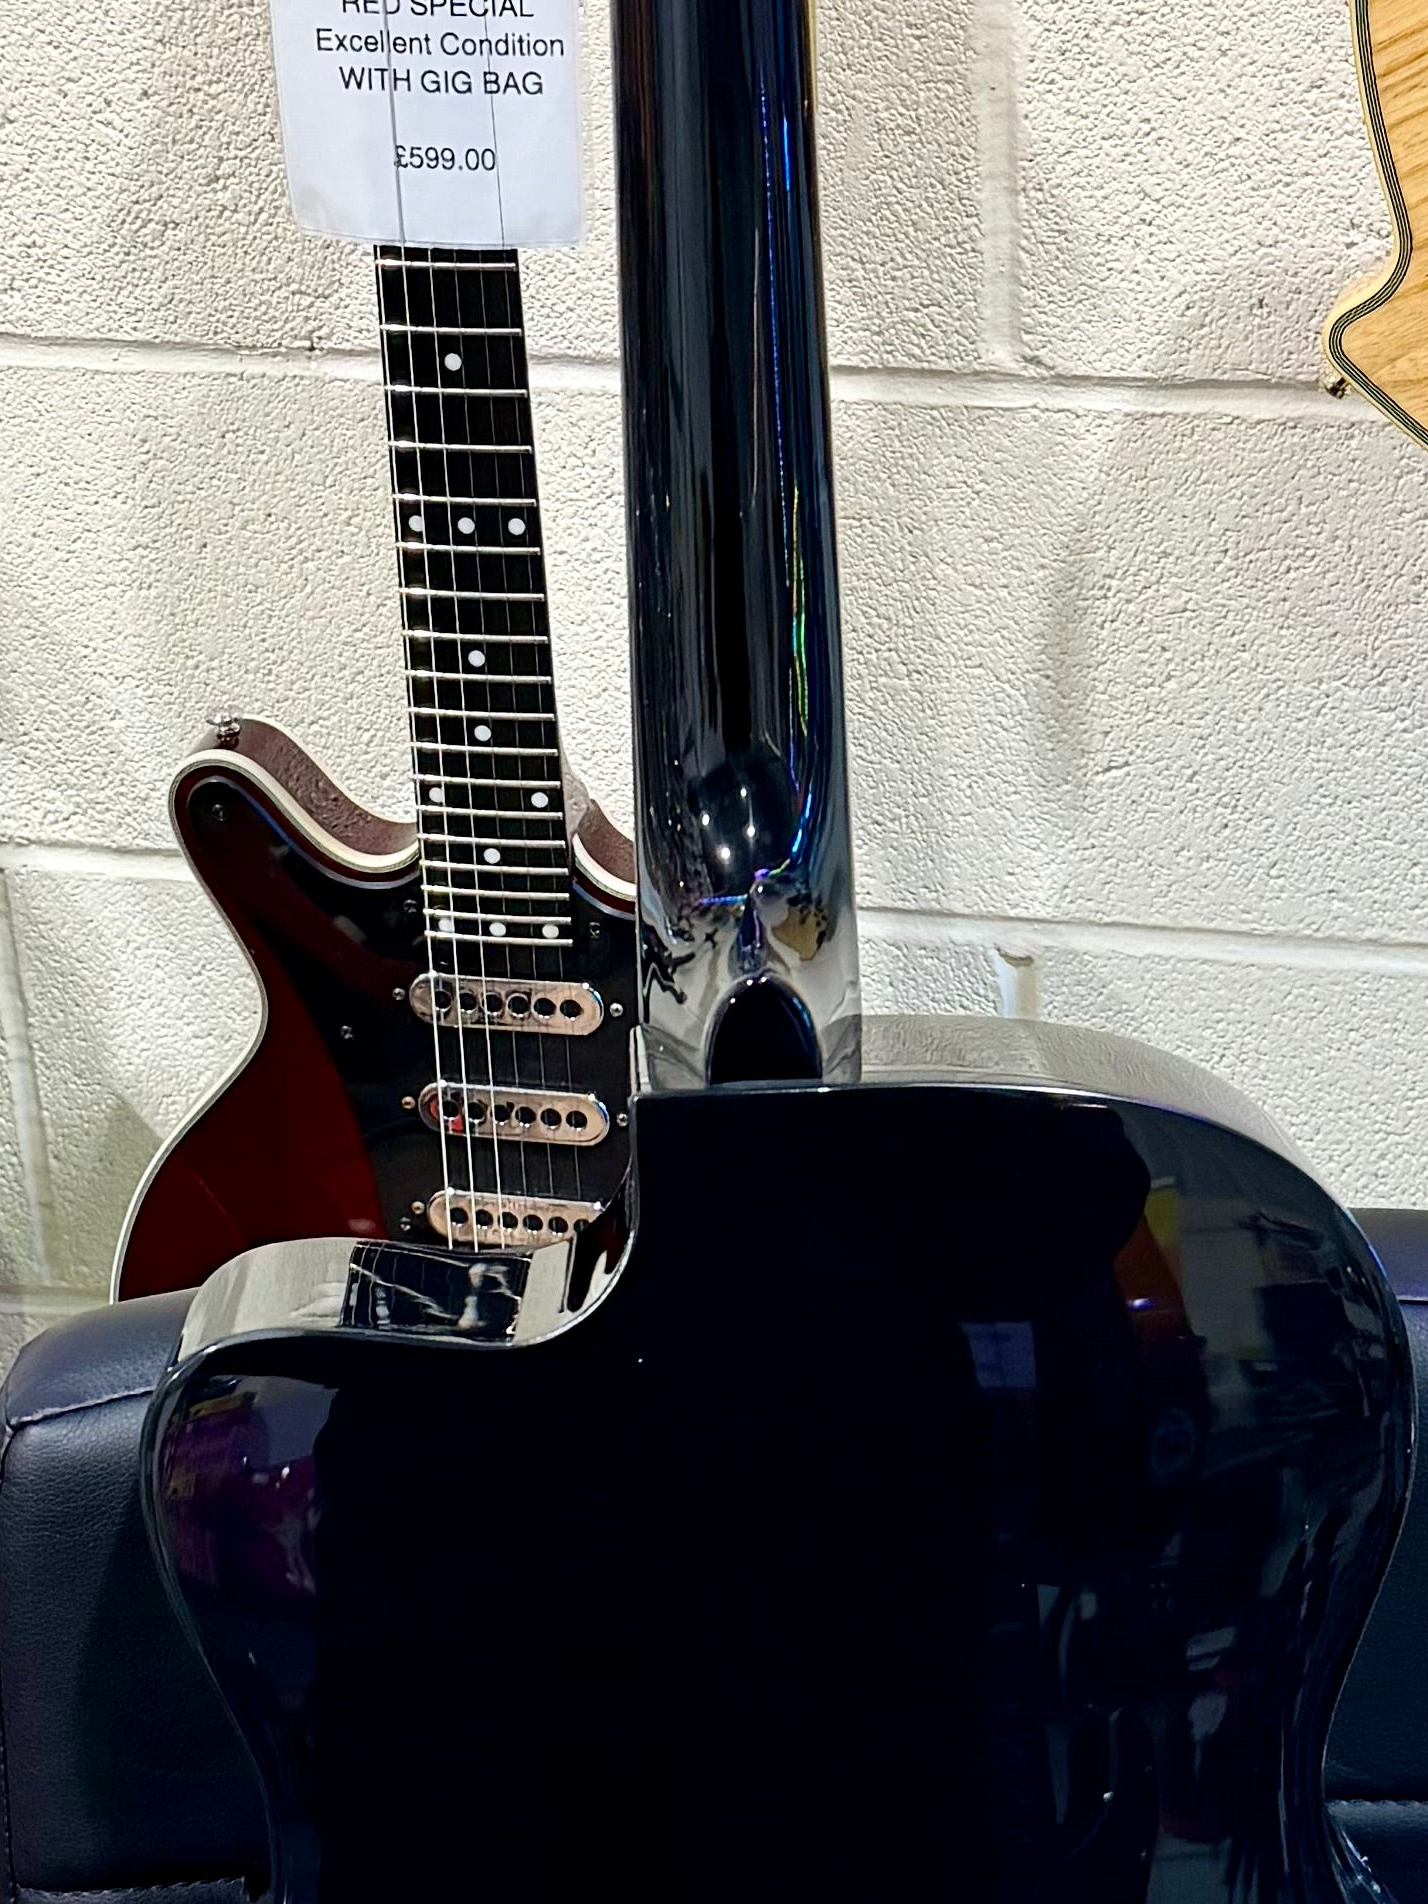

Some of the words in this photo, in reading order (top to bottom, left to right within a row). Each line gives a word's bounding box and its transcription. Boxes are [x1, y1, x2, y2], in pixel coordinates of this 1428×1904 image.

[316, 29, 432, 56] Excellent
[440, 31, 564, 57] Condition
[339, 66, 411, 93] WITH
[421, 69, 472, 94] GIG
[483, 71, 544, 96] BAG
[394, 144, 496, 172] £599.00
